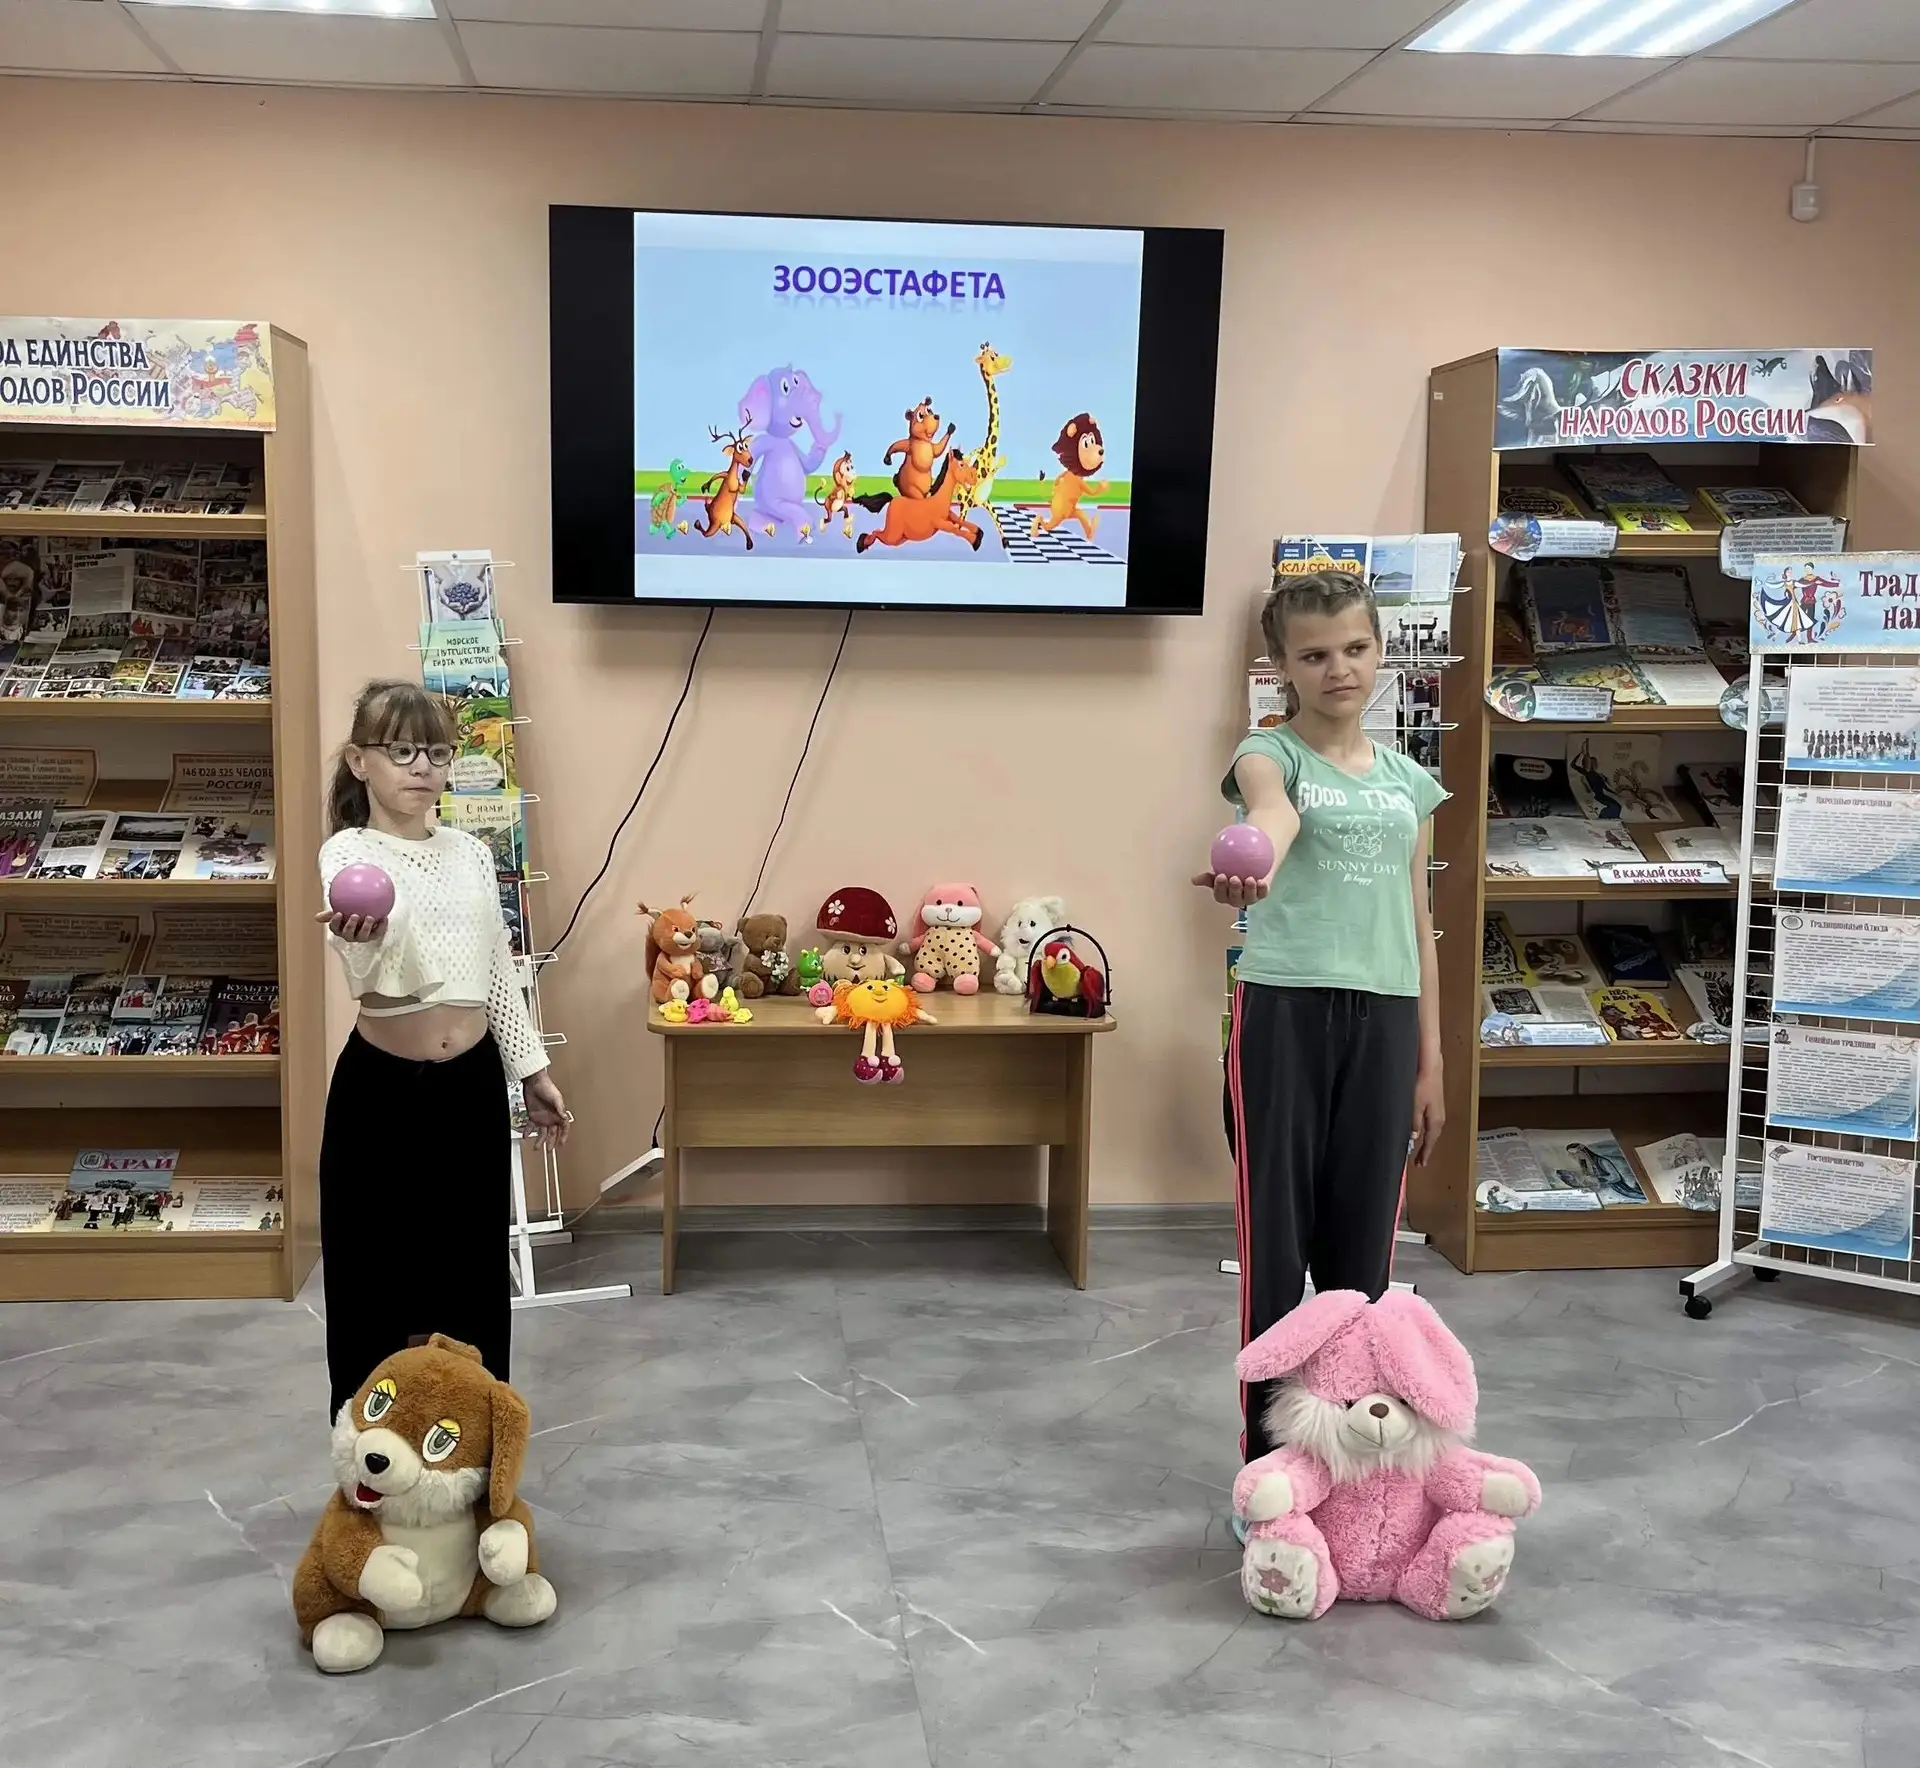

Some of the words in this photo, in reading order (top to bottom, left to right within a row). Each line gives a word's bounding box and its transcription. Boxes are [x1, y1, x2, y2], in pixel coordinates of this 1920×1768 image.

[773, 264, 1006, 300] ЗООЭСТАФЕТА
[25, 338, 150, 369] ЕДИНСТВА
[1859, 570, 1920, 603] Трад
[446, 636, 480, 646] МОРСКОЕ
[1254, 676, 1284, 687] МНО
[205, 779, 263, 790] РОССИЯ
[1297, 780, 1348, 814] GOOD
[1317, 860, 1369, 873] SUNNY
[1373, 862, 1400, 876] DAY
[1612, 869, 1622, 879] В
[1623, 866, 1666, 879] КАЖДОЙ
[1667, 868, 1702, 879] СКАЗКЕ
[217, 992, 279, 1003] ИСКУССТ
[103, 1153, 175, 1171] КРАЙ
